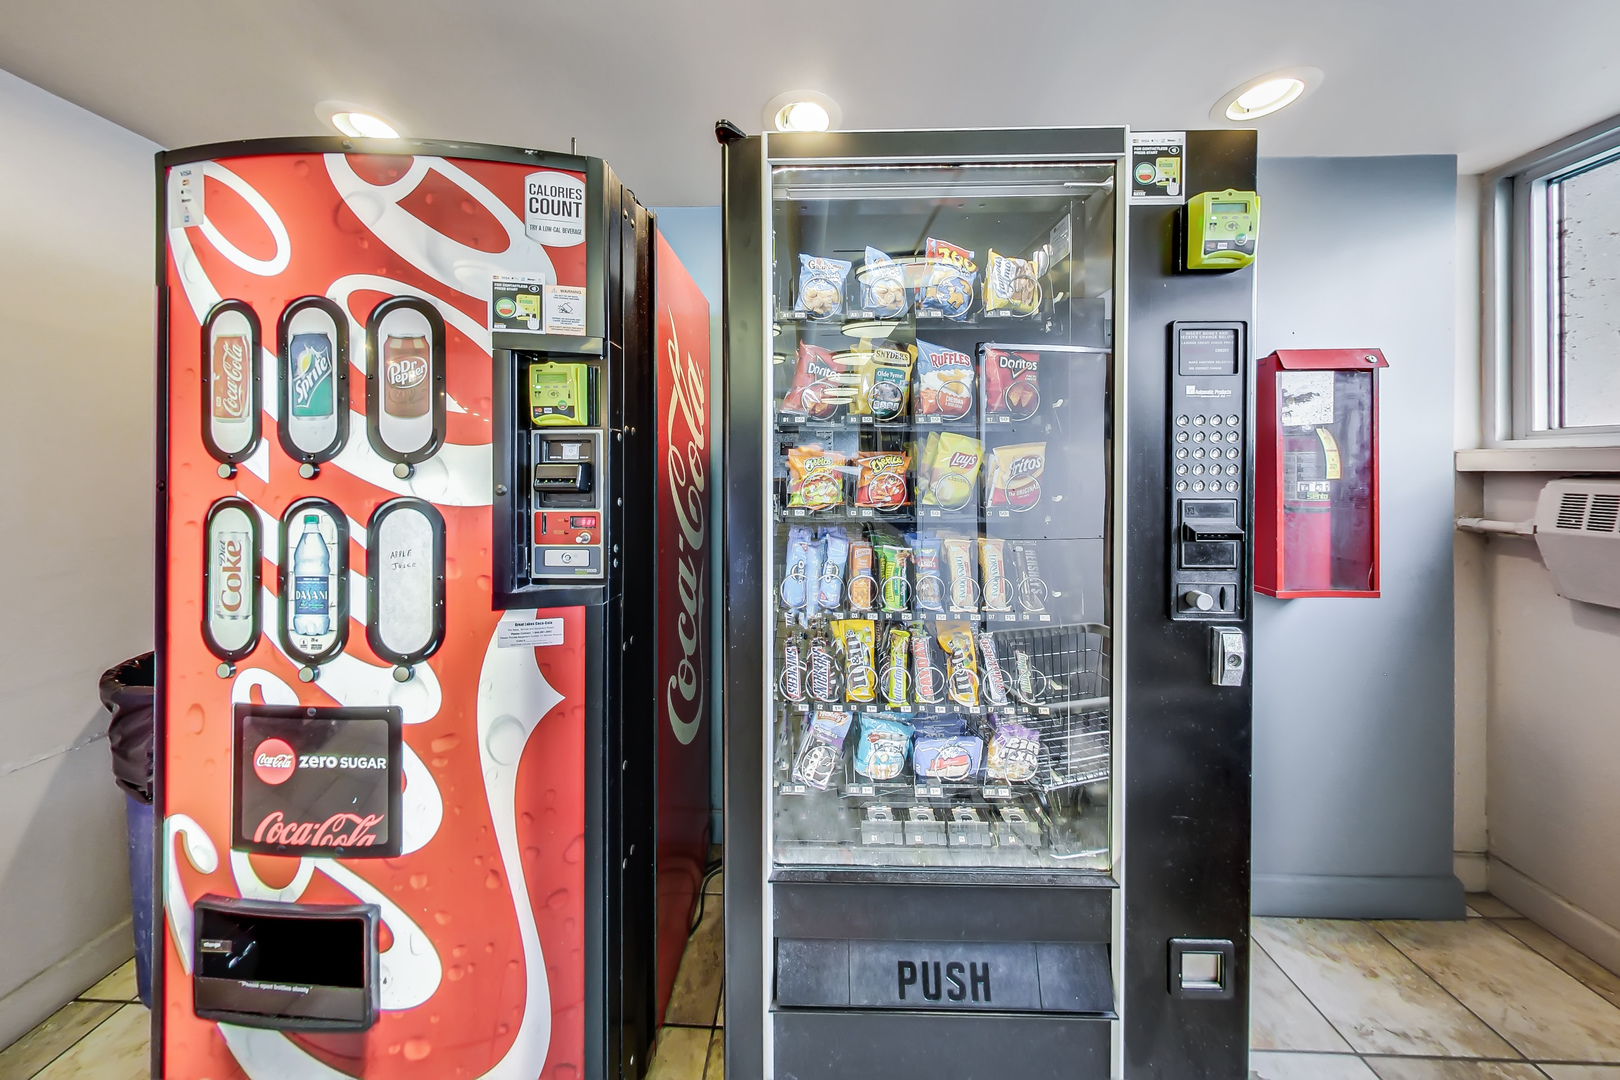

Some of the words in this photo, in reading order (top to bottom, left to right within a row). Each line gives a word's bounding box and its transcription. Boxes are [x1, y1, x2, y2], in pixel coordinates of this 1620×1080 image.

[529, 183, 583, 201] CALORIES
[529, 196, 583, 219] COUNT
[562, 227, 583, 236] BEVERAGE
[400, 360, 419, 375] Dr
[930, 352, 971, 369] RUFFLES
[999, 356, 1038, 371] Doritos
[222, 340, 244, 417] Coca-Cola
[295, 352, 329, 404] Sprite
[391, 363, 427, 387] Pepper
[952, 453, 979, 469] Lay's
[1009, 457, 1044, 477] Fritos
[666, 304, 709, 746] Coca-Cola
[390, 549, 412, 559] APPLE
[221, 540, 243, 612] Coke
[296, 588, 328, 601] DASANI
[915, 641, 933, 696] PAYDAY
[255, 753, 293, 769] Coca-Cola
[298, 755, 339, 769] zero
[339, 757, 388, 770] SUGAR
[253, 810, 386, 848] Coca-Cola
[897, 960, 991, 1003] PUSH
